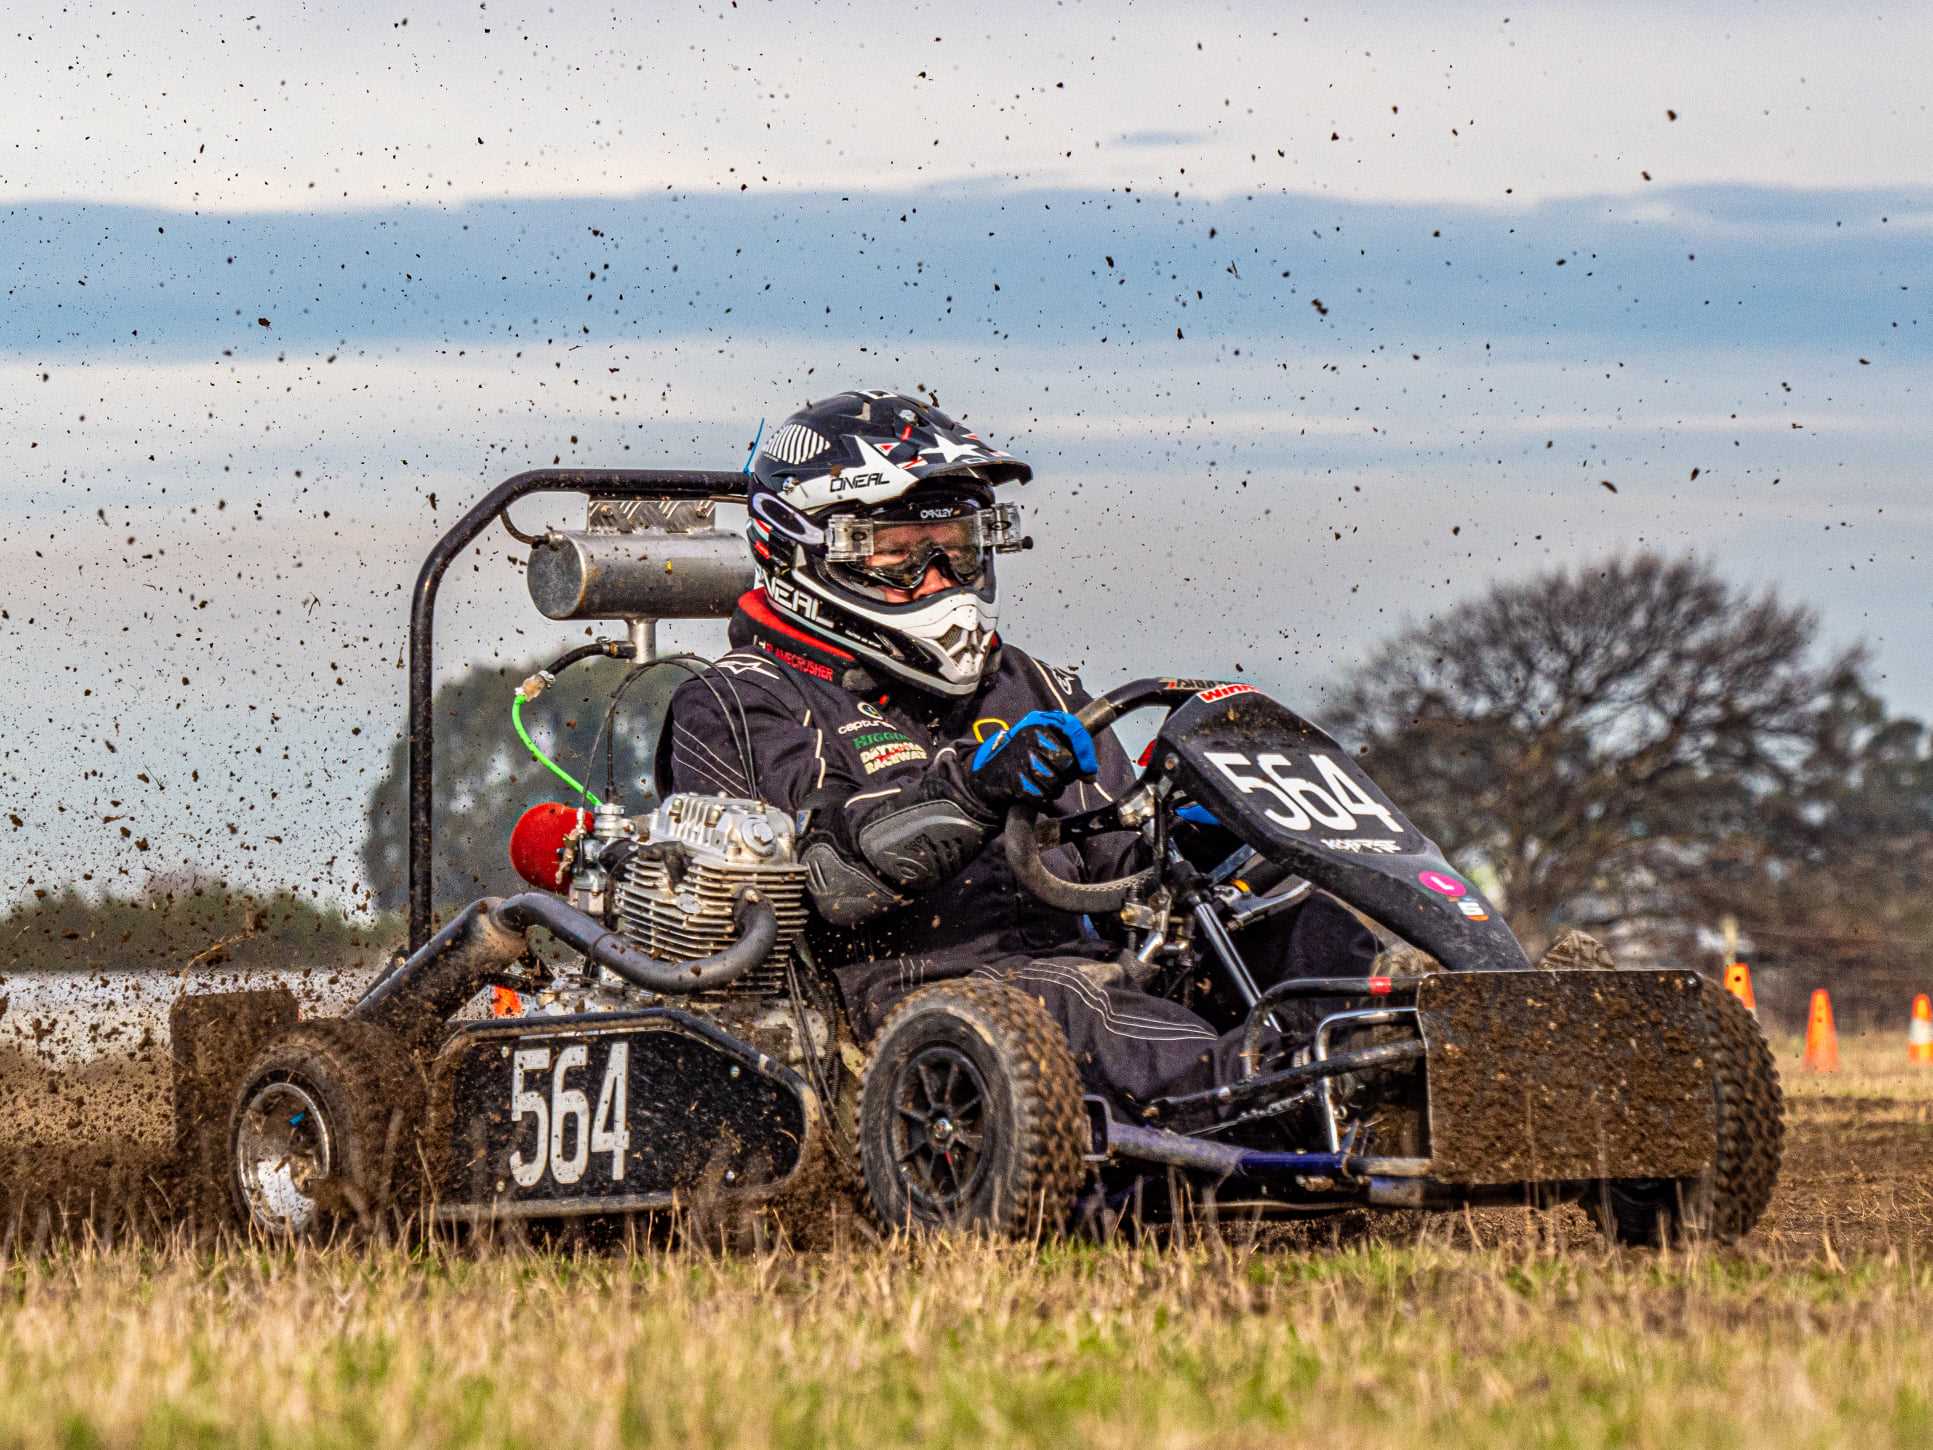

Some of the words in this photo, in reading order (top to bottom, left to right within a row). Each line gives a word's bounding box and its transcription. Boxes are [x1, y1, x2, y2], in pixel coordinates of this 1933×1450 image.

[754, 566, 835, 629] NEAL
[1203, 751, 1405, 832] 564
[509, 1041, 631, 1188] 564
